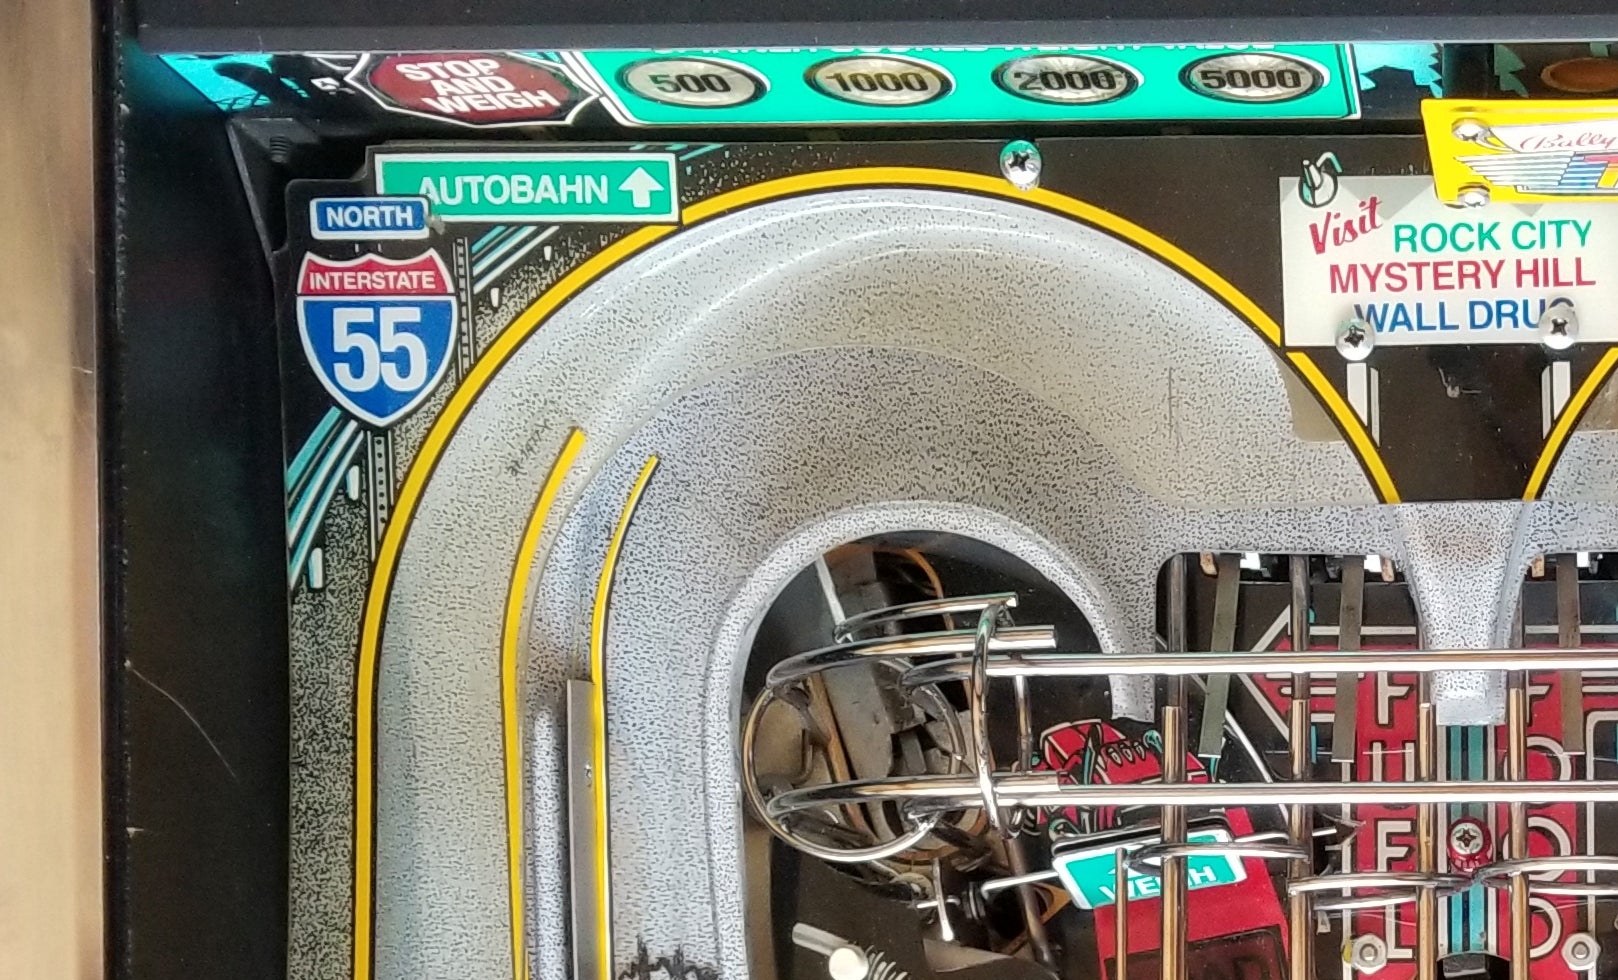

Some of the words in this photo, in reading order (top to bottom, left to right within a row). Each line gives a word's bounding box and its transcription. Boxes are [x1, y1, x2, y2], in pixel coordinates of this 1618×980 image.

[396, 58, 501, 82] STOP
[827, 71, 929, 93] 1000
[1014, 70, 1115, 92] 2000
[1200, 67, 1303, 91] 5000
[429, 75, 516, 97] AND
[653, 73, 731, 95] 500
[421, 89, 561, 114] WEIGH
[1519, 130, 1617, 151] Bally
[418, 174, 609, 205] AUTOBAHN
[325, 205, 414, 228] NORTH
[1308, 196, 1384, 255] Visit
[1393, 220, 1502, 254] ROCK
[1511, 219, 1593, 251] CITY
[309, 270, 436, 290] INTERSTATE
[1329, 259, 1506, 294] MYSTERY
[1515, 256, 1598, 288] HILL
[1354, 301, 1460, 333] WALL
[332, 307, 428, 393] 55
